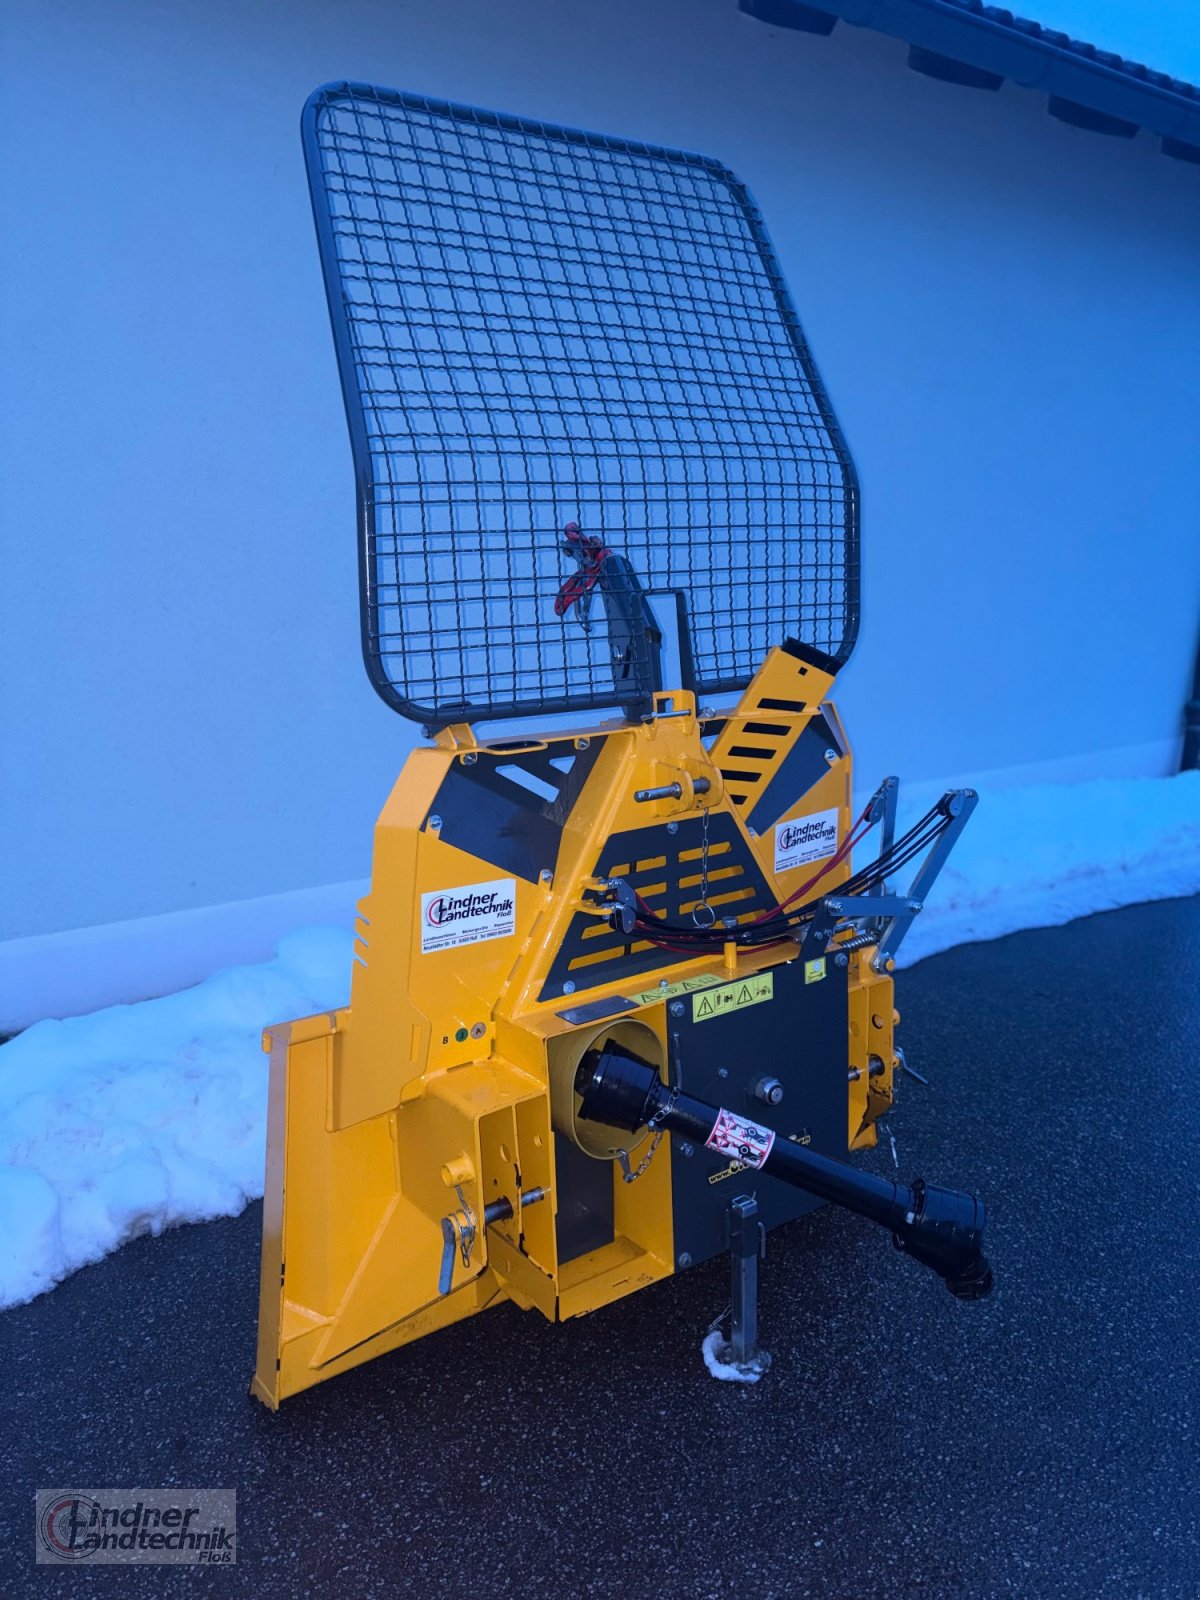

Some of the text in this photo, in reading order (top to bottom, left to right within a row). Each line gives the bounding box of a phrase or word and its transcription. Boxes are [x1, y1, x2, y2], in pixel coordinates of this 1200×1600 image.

[786, 825, 837, 849] Landtechnik
[787, 820, 826, 840] Lindner
[438, 892, 498, 912] Lindner
[438, 899, 514, 924] Landtechnik
[442, 1036, 449, 1045] B
[475, 1027, 482, 1035] A
